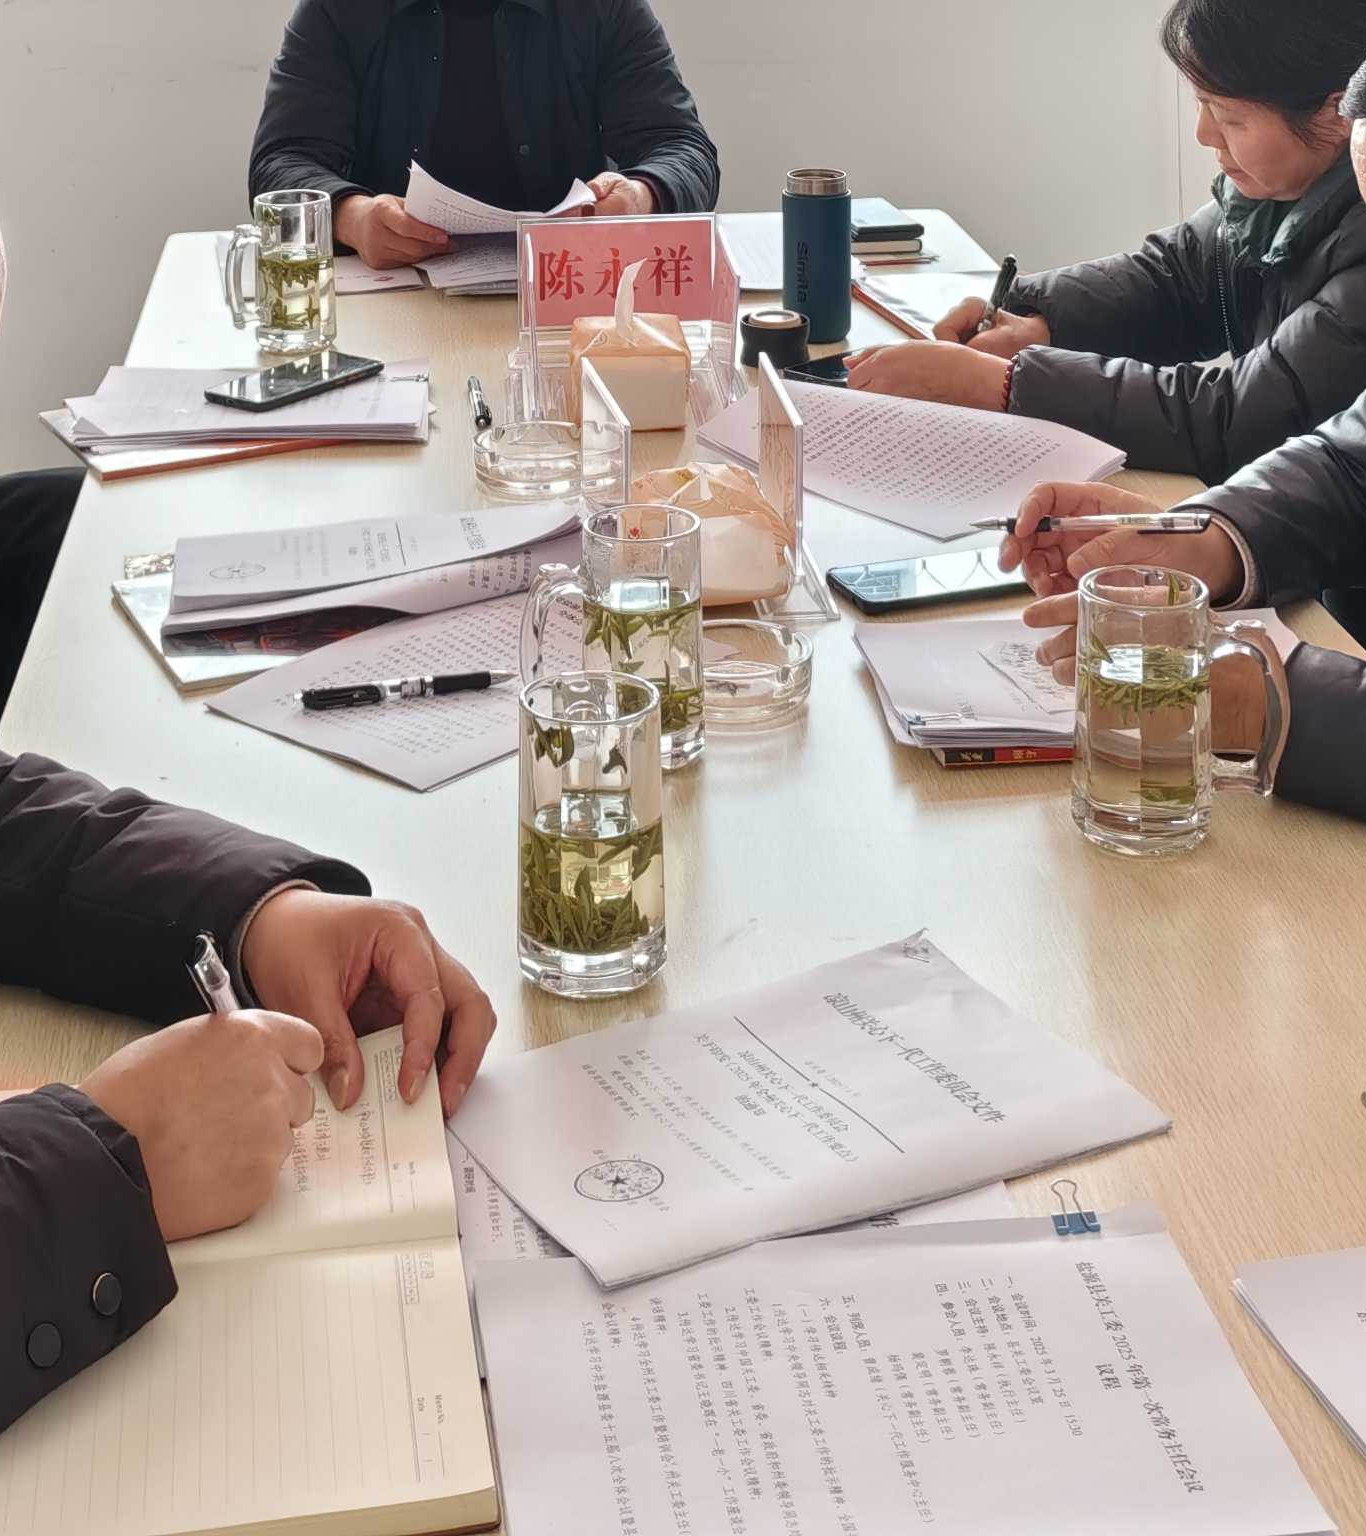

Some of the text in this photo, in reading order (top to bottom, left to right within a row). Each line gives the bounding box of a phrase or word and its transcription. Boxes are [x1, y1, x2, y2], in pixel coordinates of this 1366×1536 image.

[538, 243, 694, 301] 陈永祥
[1094, 1362, 1121, 1390] 议程
